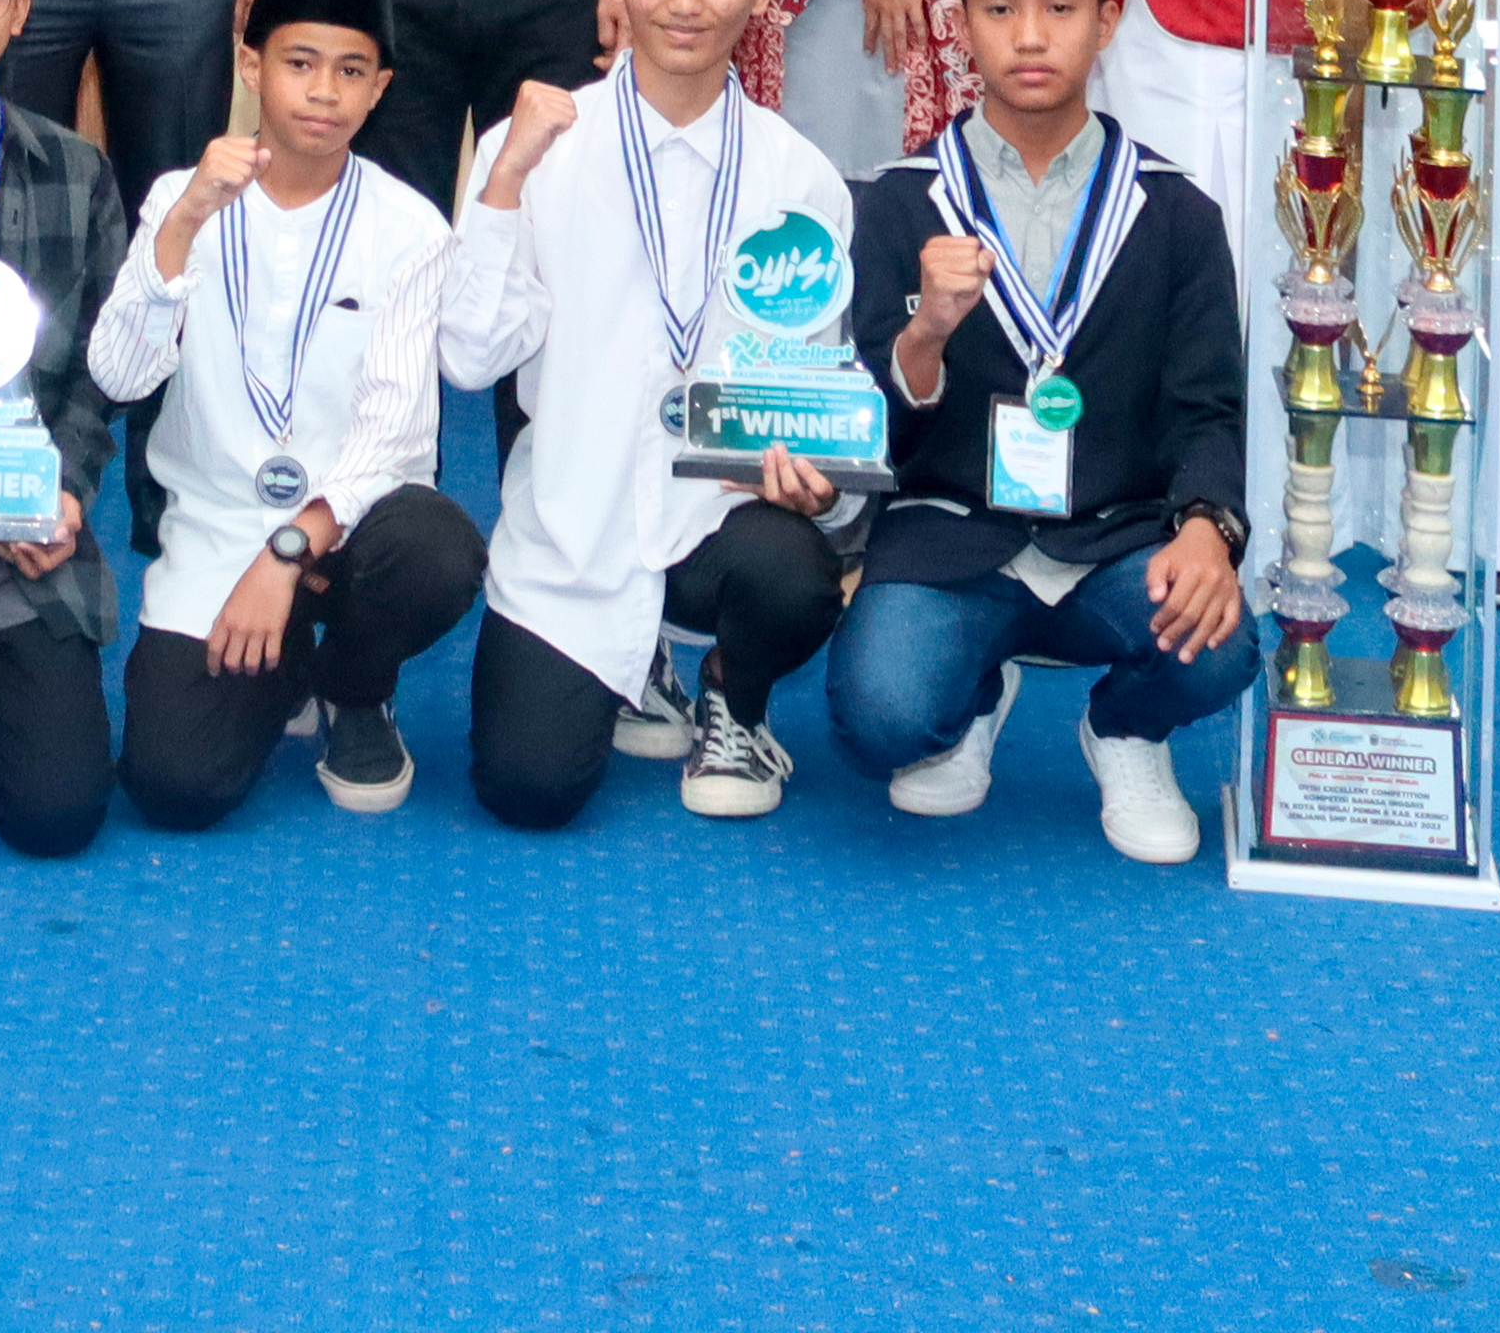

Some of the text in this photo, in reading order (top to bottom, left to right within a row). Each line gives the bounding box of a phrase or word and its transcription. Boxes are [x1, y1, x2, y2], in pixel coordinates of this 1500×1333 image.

[735, 246, 841, 298] Oyisi
[768, 343, 854, 360] Excellent
[707, 406, 871, 442] 1st WINNER
[1293, 749, 1436, 773] GENERAL WINNER
